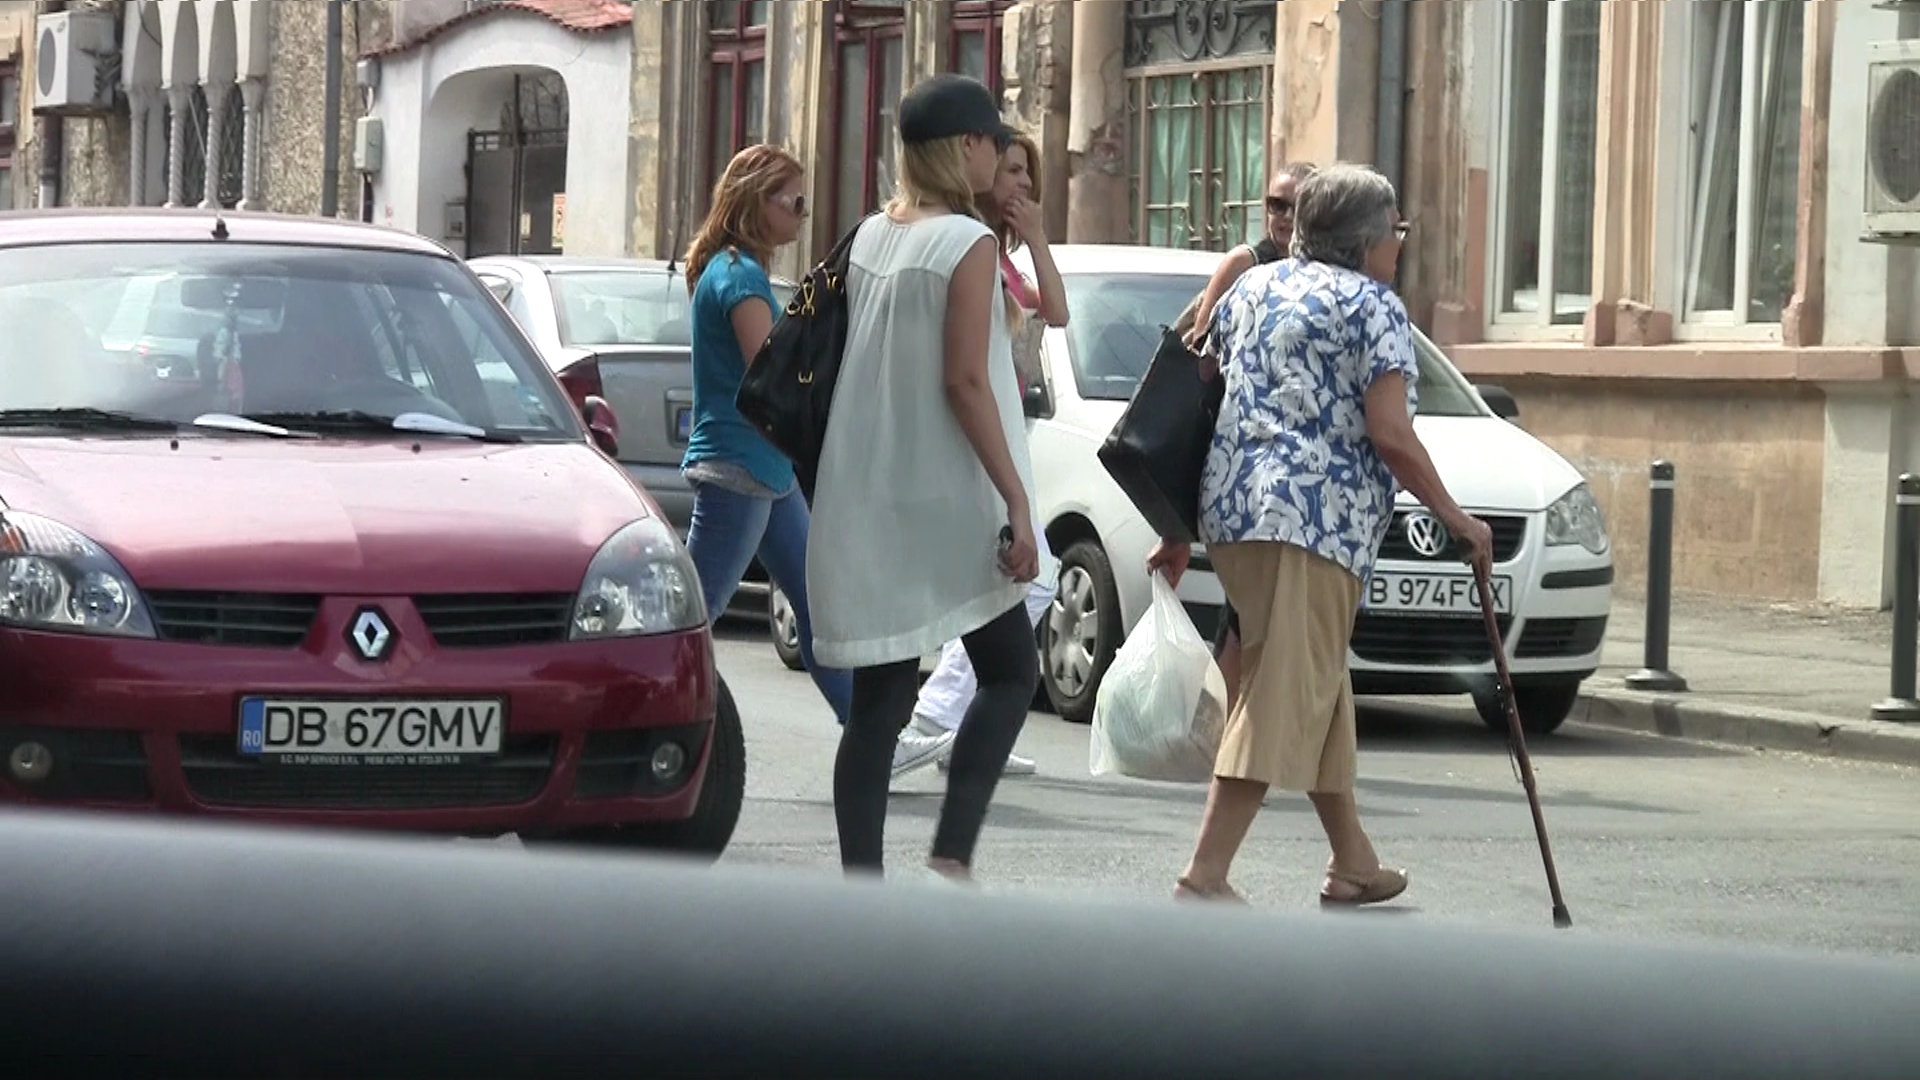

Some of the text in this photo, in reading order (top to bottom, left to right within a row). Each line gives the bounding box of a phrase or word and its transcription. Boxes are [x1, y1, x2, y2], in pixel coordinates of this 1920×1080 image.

[1369, 578, 1388, 604] B
[242, 730, 261, 747] RO
[264, 706, 495, 748] DB 67GMV
